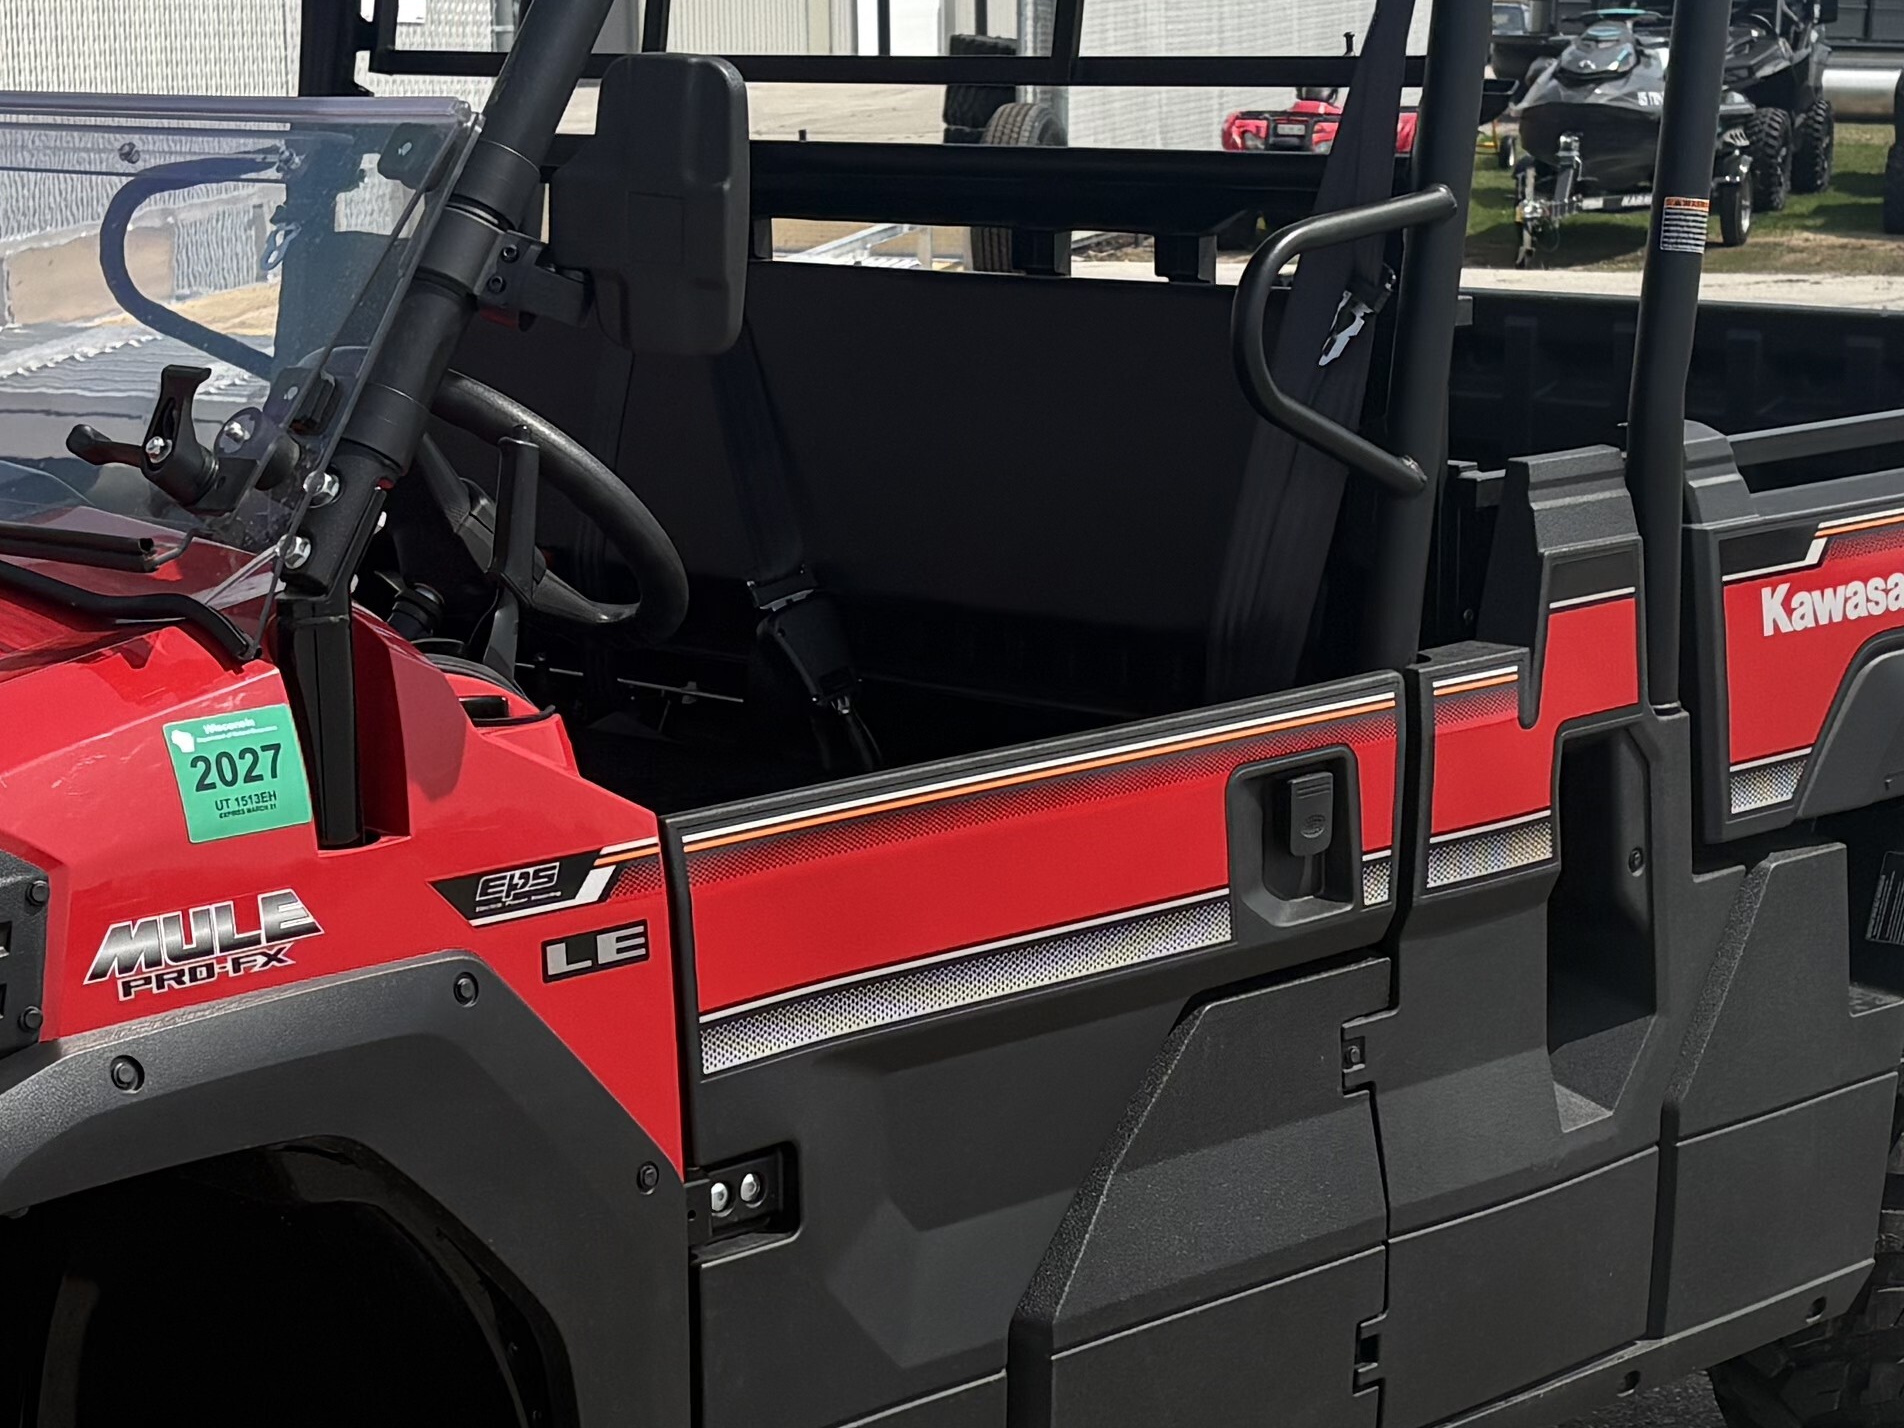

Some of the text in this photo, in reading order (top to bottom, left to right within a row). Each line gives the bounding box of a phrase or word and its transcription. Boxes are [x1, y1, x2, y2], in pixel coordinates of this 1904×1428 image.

[190, 743, 281, 792] 2027
[215, 790, 277, 811] UT 1513EH
[476, 862, 560, 902] EPS
[83, 888, 325, 985] MULE
[546, 925, 646, 975] LE
[116, 942, 297, 1002] PRO-FX
